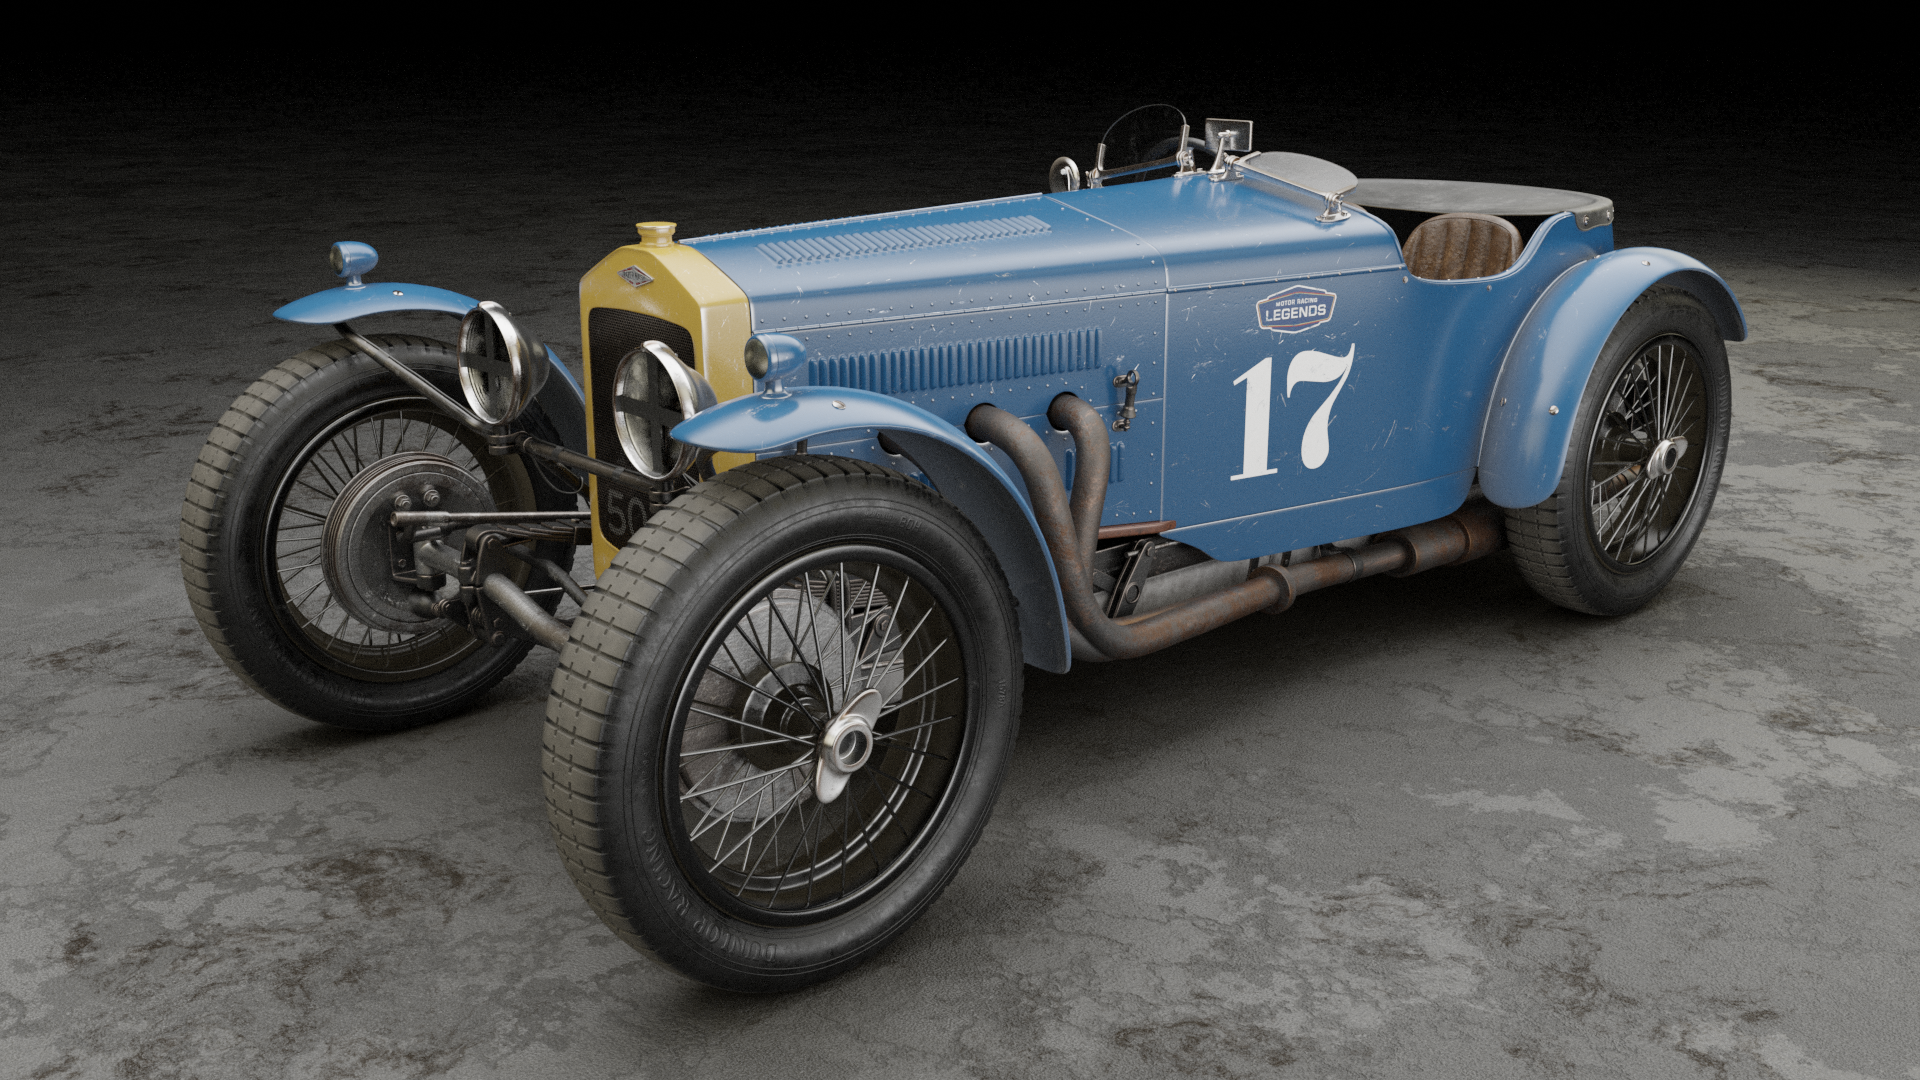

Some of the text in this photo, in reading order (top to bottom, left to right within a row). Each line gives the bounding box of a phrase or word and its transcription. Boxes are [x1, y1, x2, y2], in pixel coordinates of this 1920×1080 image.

[1265, 304, 1327, 322] LEGENDS
[1275, 297, 1318, 307] MOTOR RACING
[1230, 343, 1356, 481] 17
[641, 825, 777, 963] DUNLOP RACING
